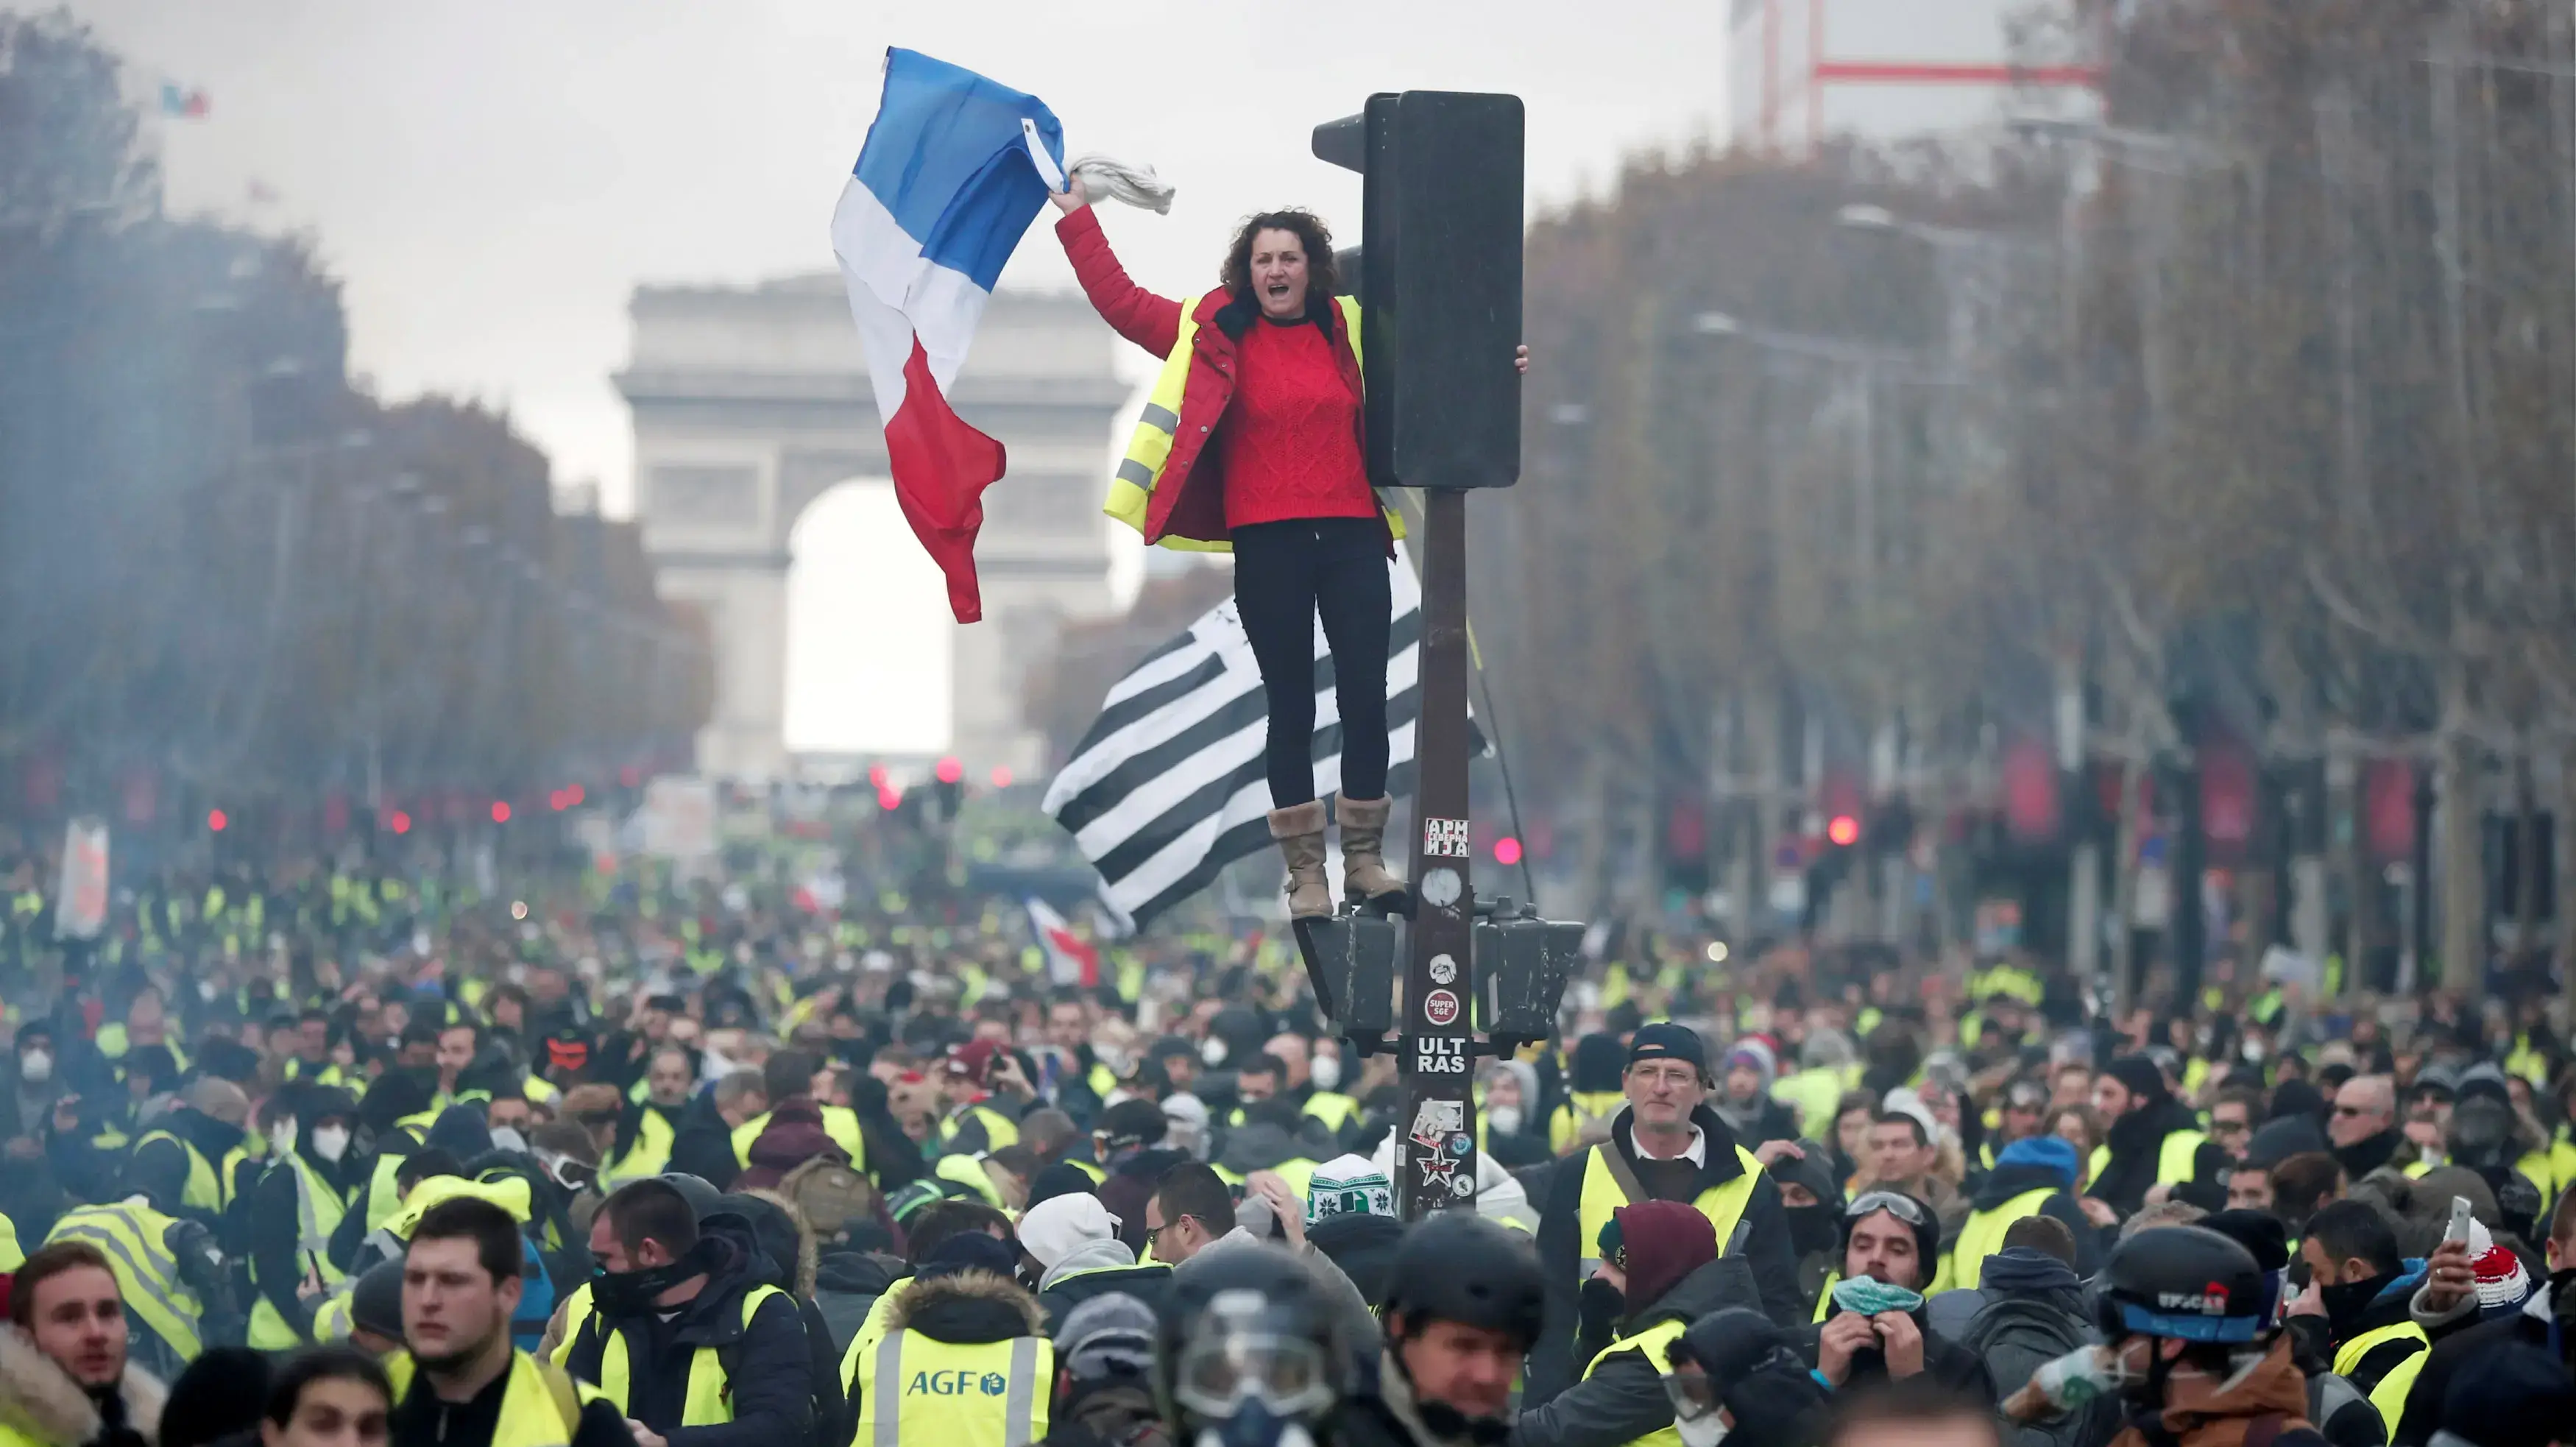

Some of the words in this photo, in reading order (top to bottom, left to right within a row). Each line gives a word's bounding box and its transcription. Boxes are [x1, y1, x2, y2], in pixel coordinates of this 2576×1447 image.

[1429, 820, 1468, 835] АРМ
[1429, 1000, 1454, 1008] SUPER
[1434, 1008, 1449, 1016] SGE
[1418, 1037, 1466, 1055] ULT
[1418, 1055, 1465, 1073] RAS
[907, 1370, 977, 1396] AGF
